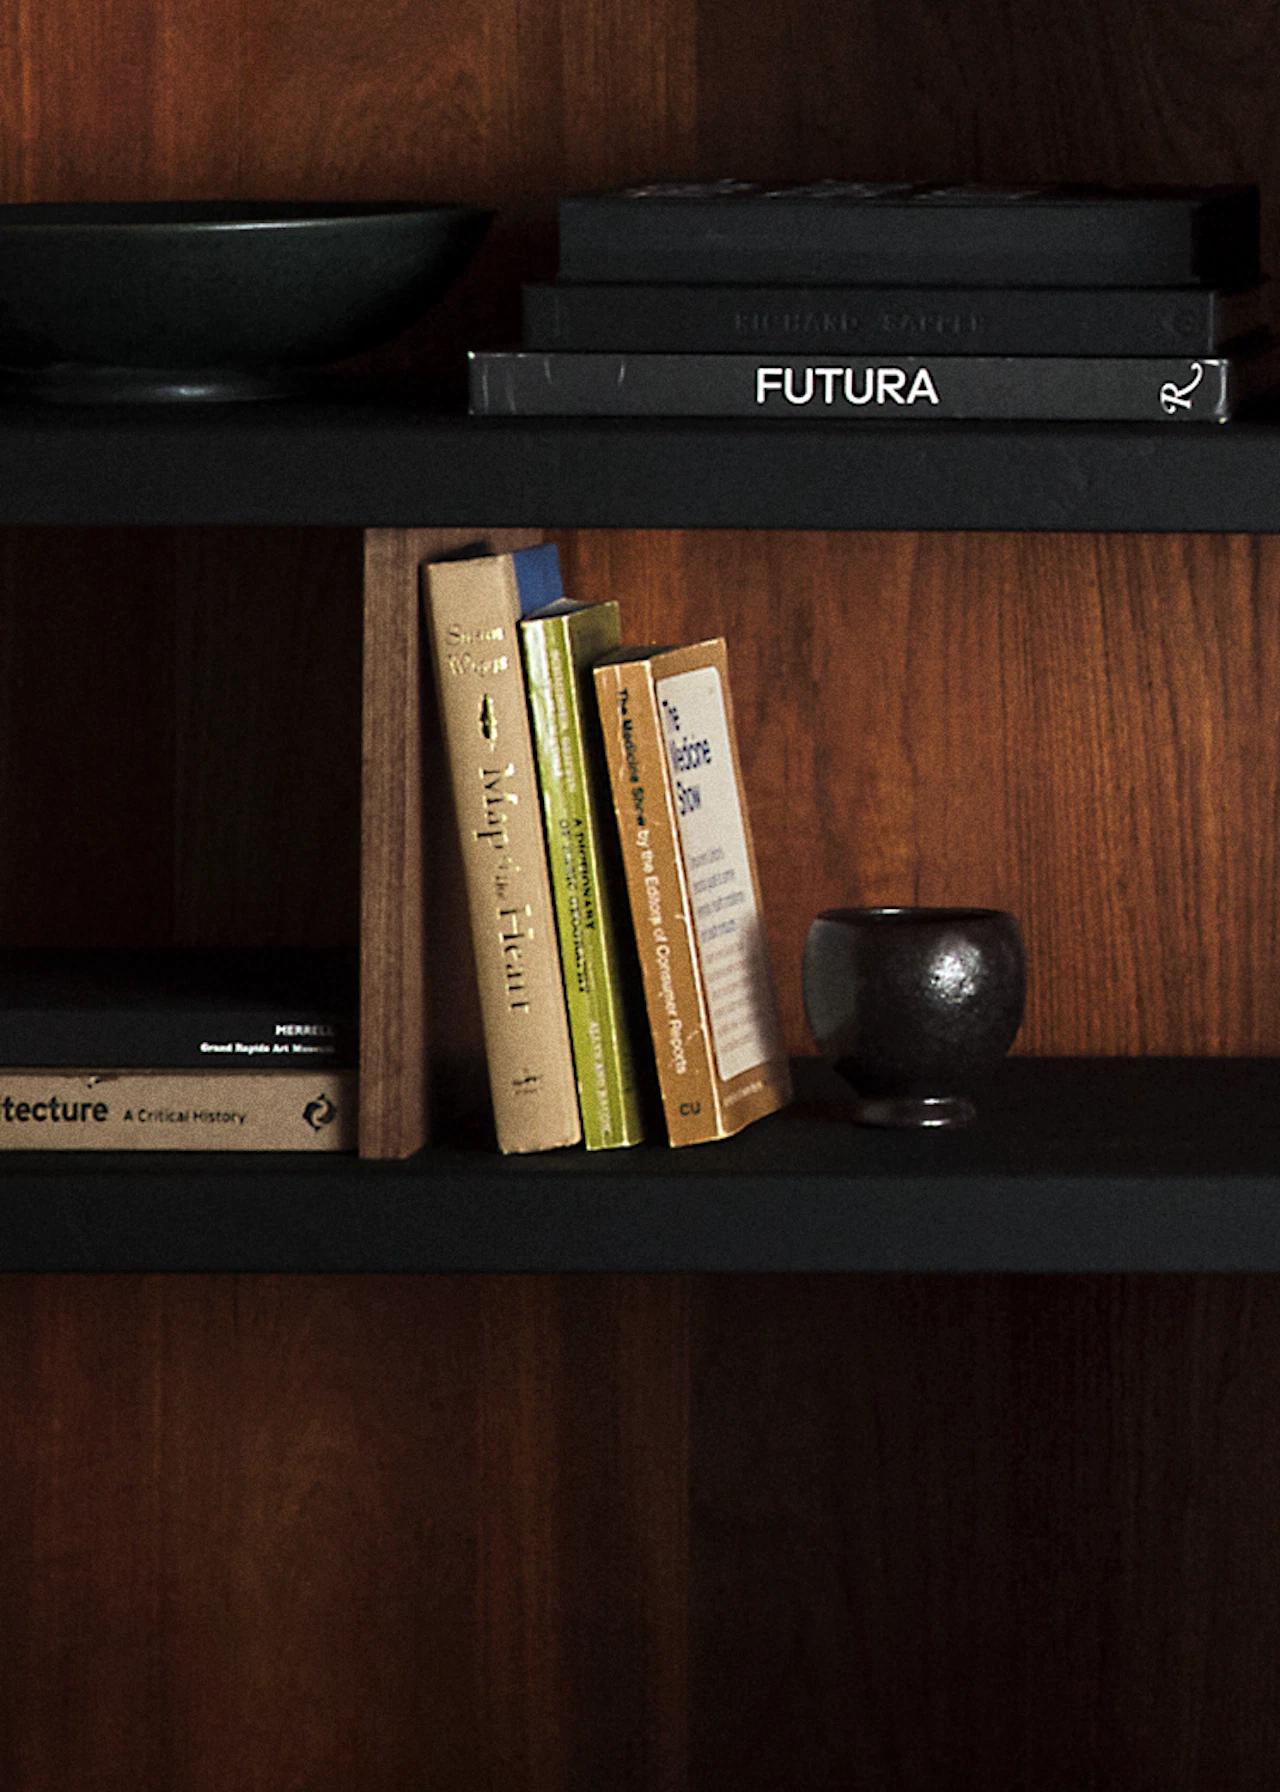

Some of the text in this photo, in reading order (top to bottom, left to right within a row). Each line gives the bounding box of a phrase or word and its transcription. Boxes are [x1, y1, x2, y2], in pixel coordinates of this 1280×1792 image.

[755, 366, 940, 405] FUTURA
[618, 689, 629, 716] The
[632, 787, 645, 826] Show
[635, 829, 650, 848] by
[641, 850, 654, 874] the
[653, 926, 668, 943] of
[4, 1096, 248, 1125] tecture A Critical History
[679, 1101, 701, 1116] CU
